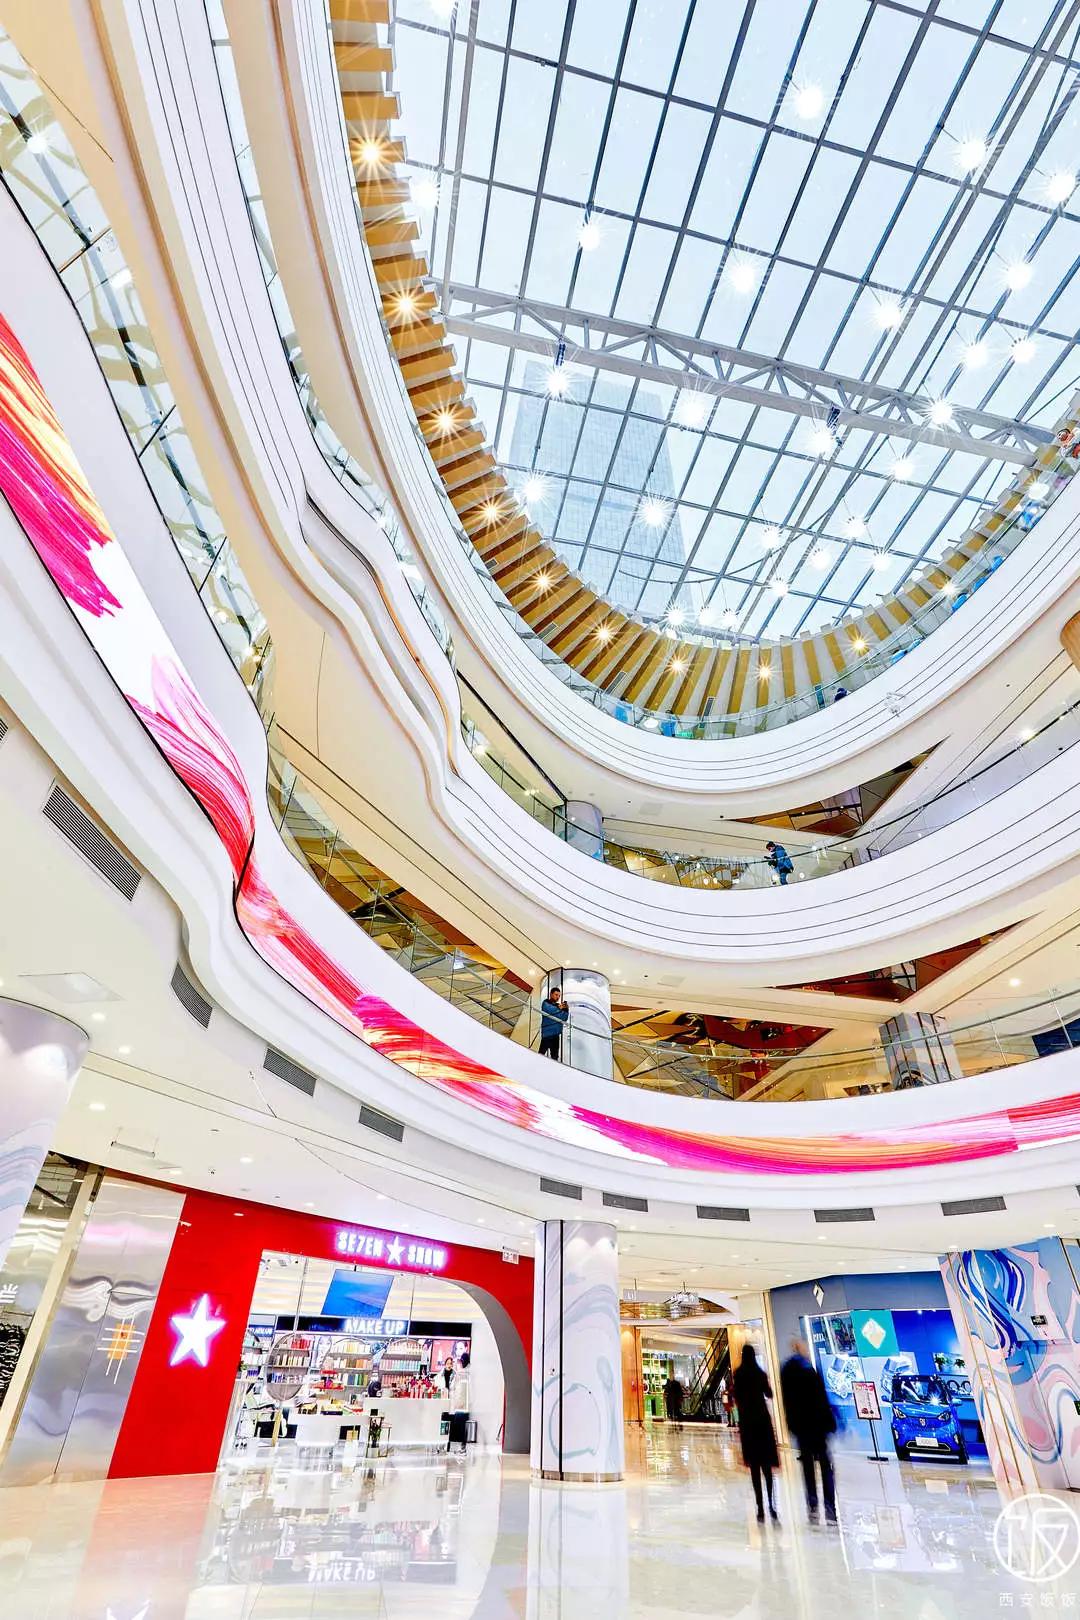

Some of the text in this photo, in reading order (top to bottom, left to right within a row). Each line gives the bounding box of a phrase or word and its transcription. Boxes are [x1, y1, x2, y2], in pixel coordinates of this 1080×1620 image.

[338, 1231, 445, 1269] SE7EN SHOW
[345, 1318, 404, 1335] MAKE UP
